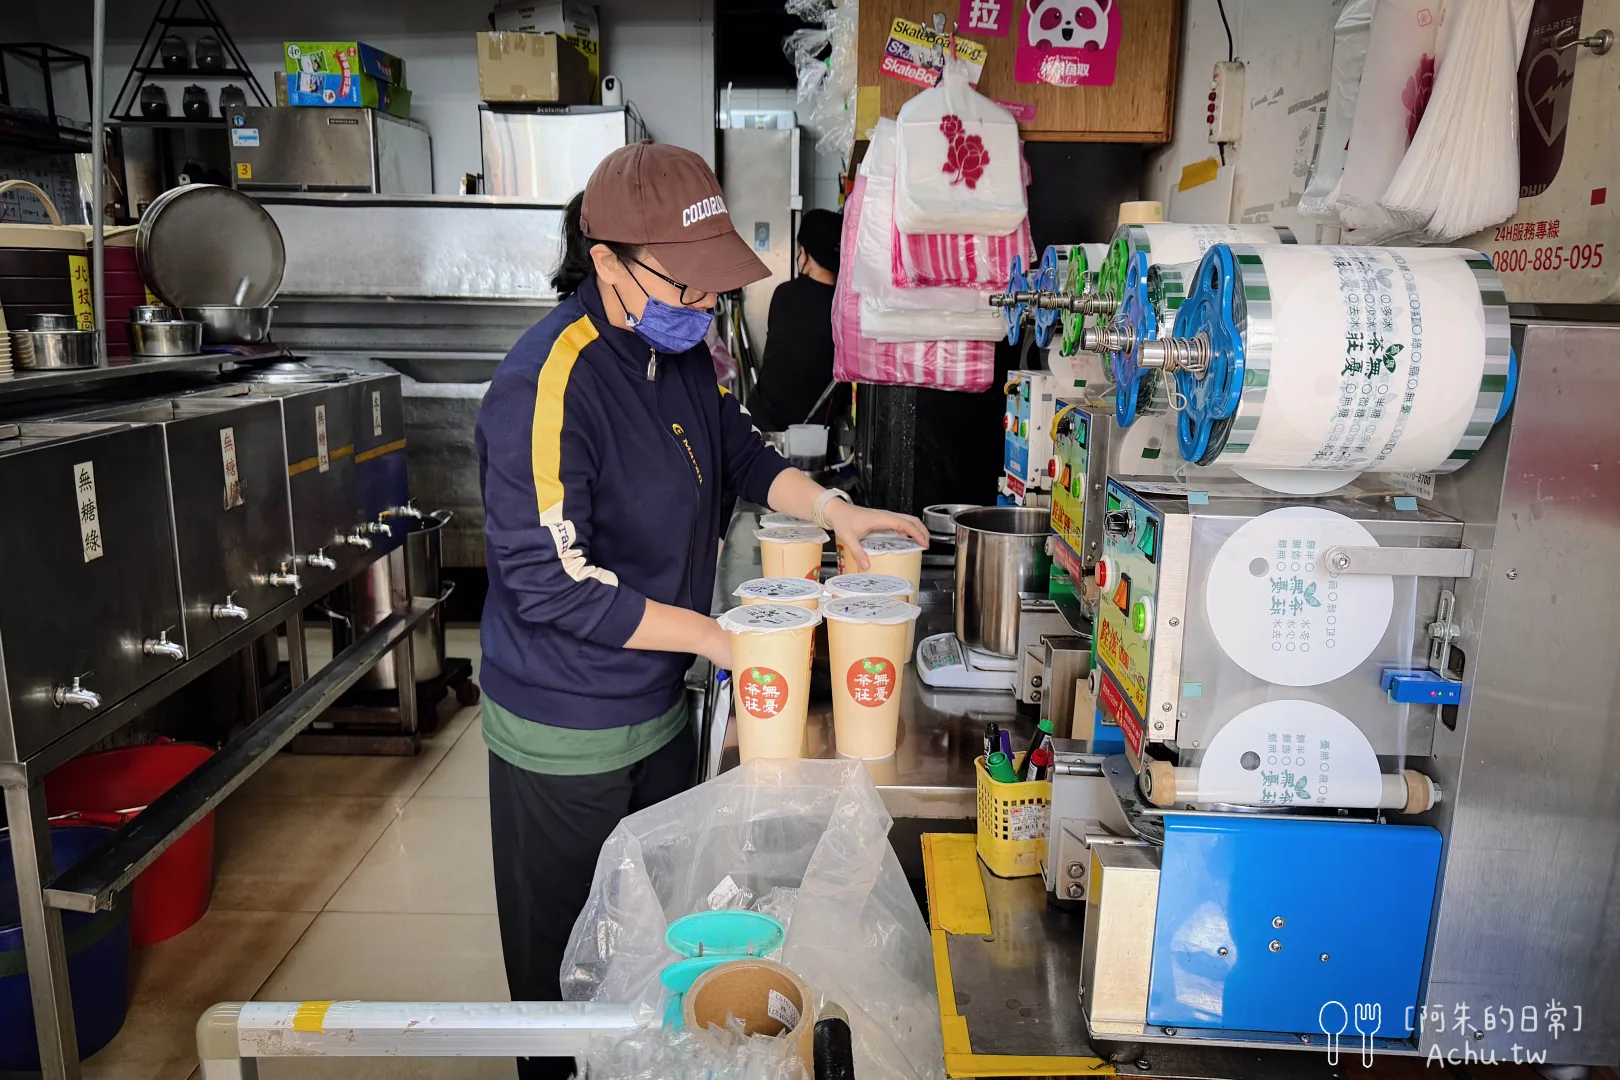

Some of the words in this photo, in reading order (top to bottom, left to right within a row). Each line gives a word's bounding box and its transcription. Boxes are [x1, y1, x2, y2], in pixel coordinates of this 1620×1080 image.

[969, 0, 1000, 30] 拉
[1533, 15, 1582, 37] HEARTST
[894, 21, 981, 60] SkateBoading
[241, 164, 249, 176] 3
[1495, 219, 1560, 242] 24H服務專線
[1492, 243, 1604, 273] 0800-885-095
[79, 467, 101, 552] 無糖綠
